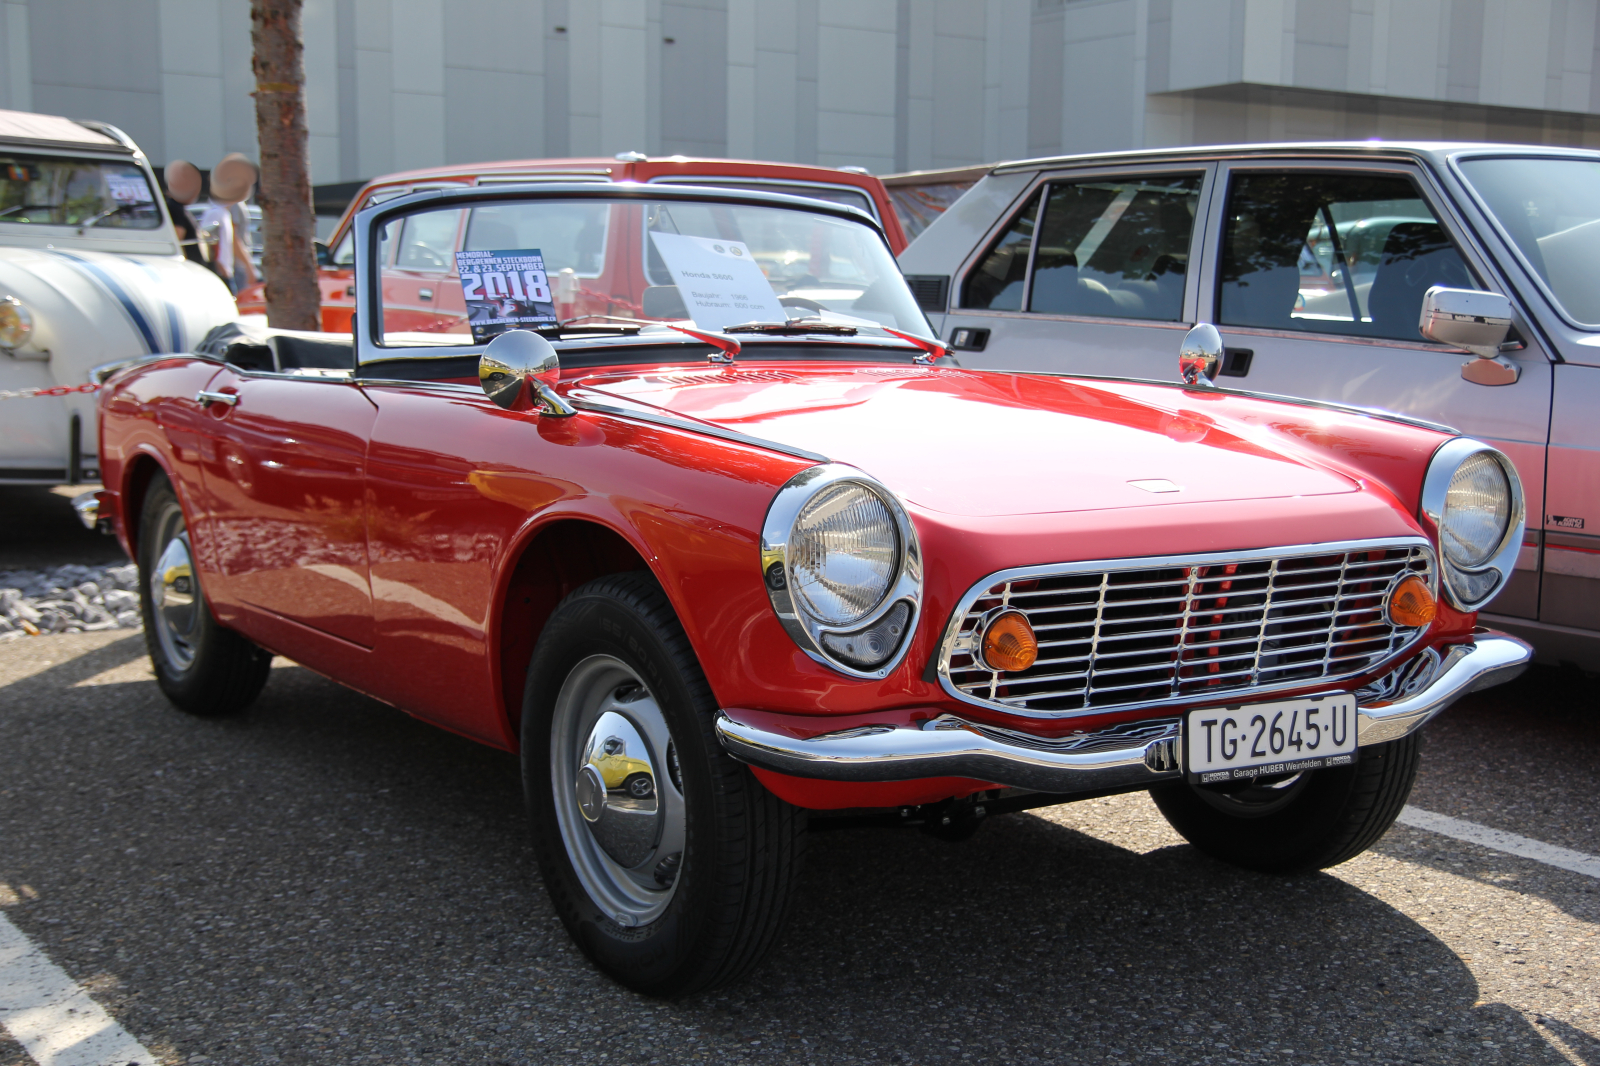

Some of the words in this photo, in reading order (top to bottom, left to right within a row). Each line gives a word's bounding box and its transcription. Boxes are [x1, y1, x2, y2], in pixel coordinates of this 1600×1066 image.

[456, 251, 494, 259] MEMORIAL-
[457, 257, 502, 266] BERGRENNEN
[502, 256, 542, 264] STECKBORN
[459, 266, 472, 274] 22.
[482, 264, 495, 273] 23.
[497, 263, 544, 272] SEPTEMBER
[681, 271, 711, 279] Honda
[461, 270, 552, 303] 2018
[691, 291, 723, 300] Baujahr:
[696, 301, 731, 309] Hubraum:
[734, 302, 748, 310] 600
[1233, 768, 1258, 778] Garage
[1260, 763, 1284, 775] HUBER
[1285, 760, 1321, 771] Weinfelden
